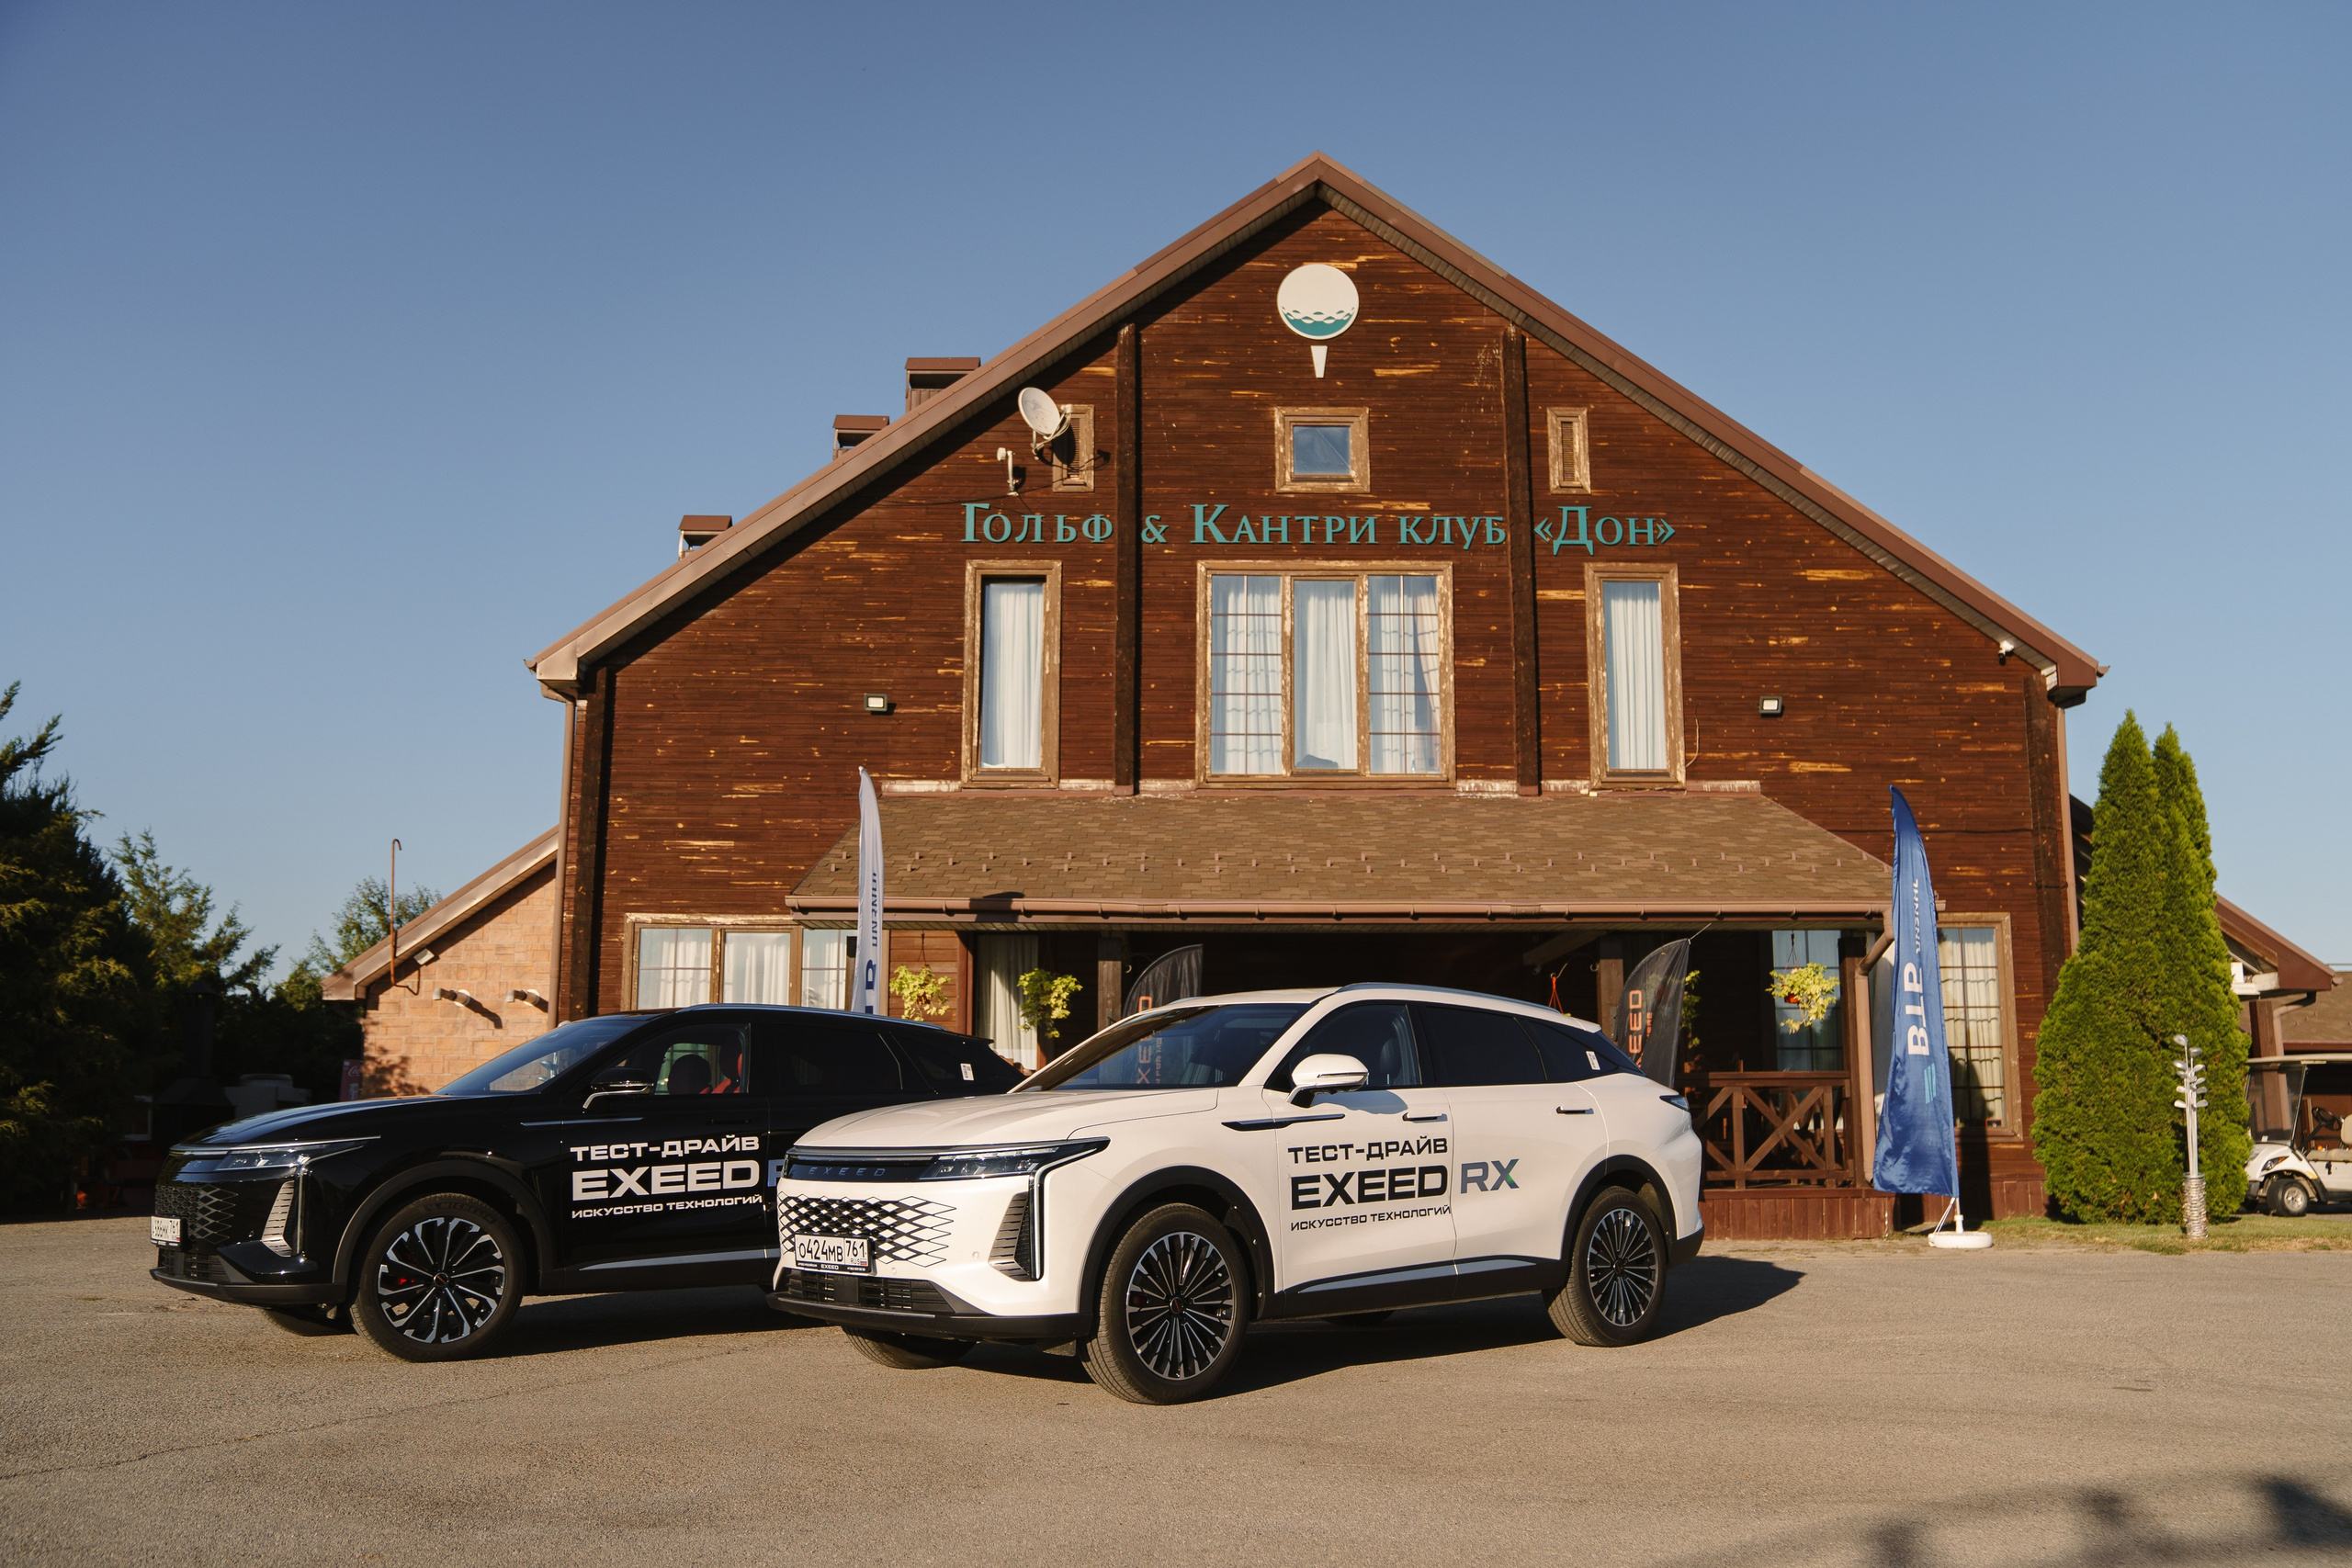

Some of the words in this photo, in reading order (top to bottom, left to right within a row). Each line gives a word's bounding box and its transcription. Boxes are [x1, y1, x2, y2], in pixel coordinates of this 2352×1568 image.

[1141, 514, 1169, 544] &
[570, 1134, 760, 1161] ТЕСТ-ДРАЙВ
[1288, 1135, 1448, 1164] ТЕСТ-ДРАЙВ
[572, 1159, 760, 1201] EXEED
[809, 1168, 886, 1177] EXEED
[1291, 1165, 1448, 1211] EXEED
[1460, 1158, 1521, 1194] RX
[571, 1203, 663, 1219] ИСКУССТВО
[666, 1194, 763, 1211] ТЕХНОЛОГИЙ
[1291, 1214, 1367, 1231] ИСКУССТВО
[1370, 1204, 1451, 1223] ТЕХНОЛОГИЙ
[845, 1240, 865, 1258] 761
